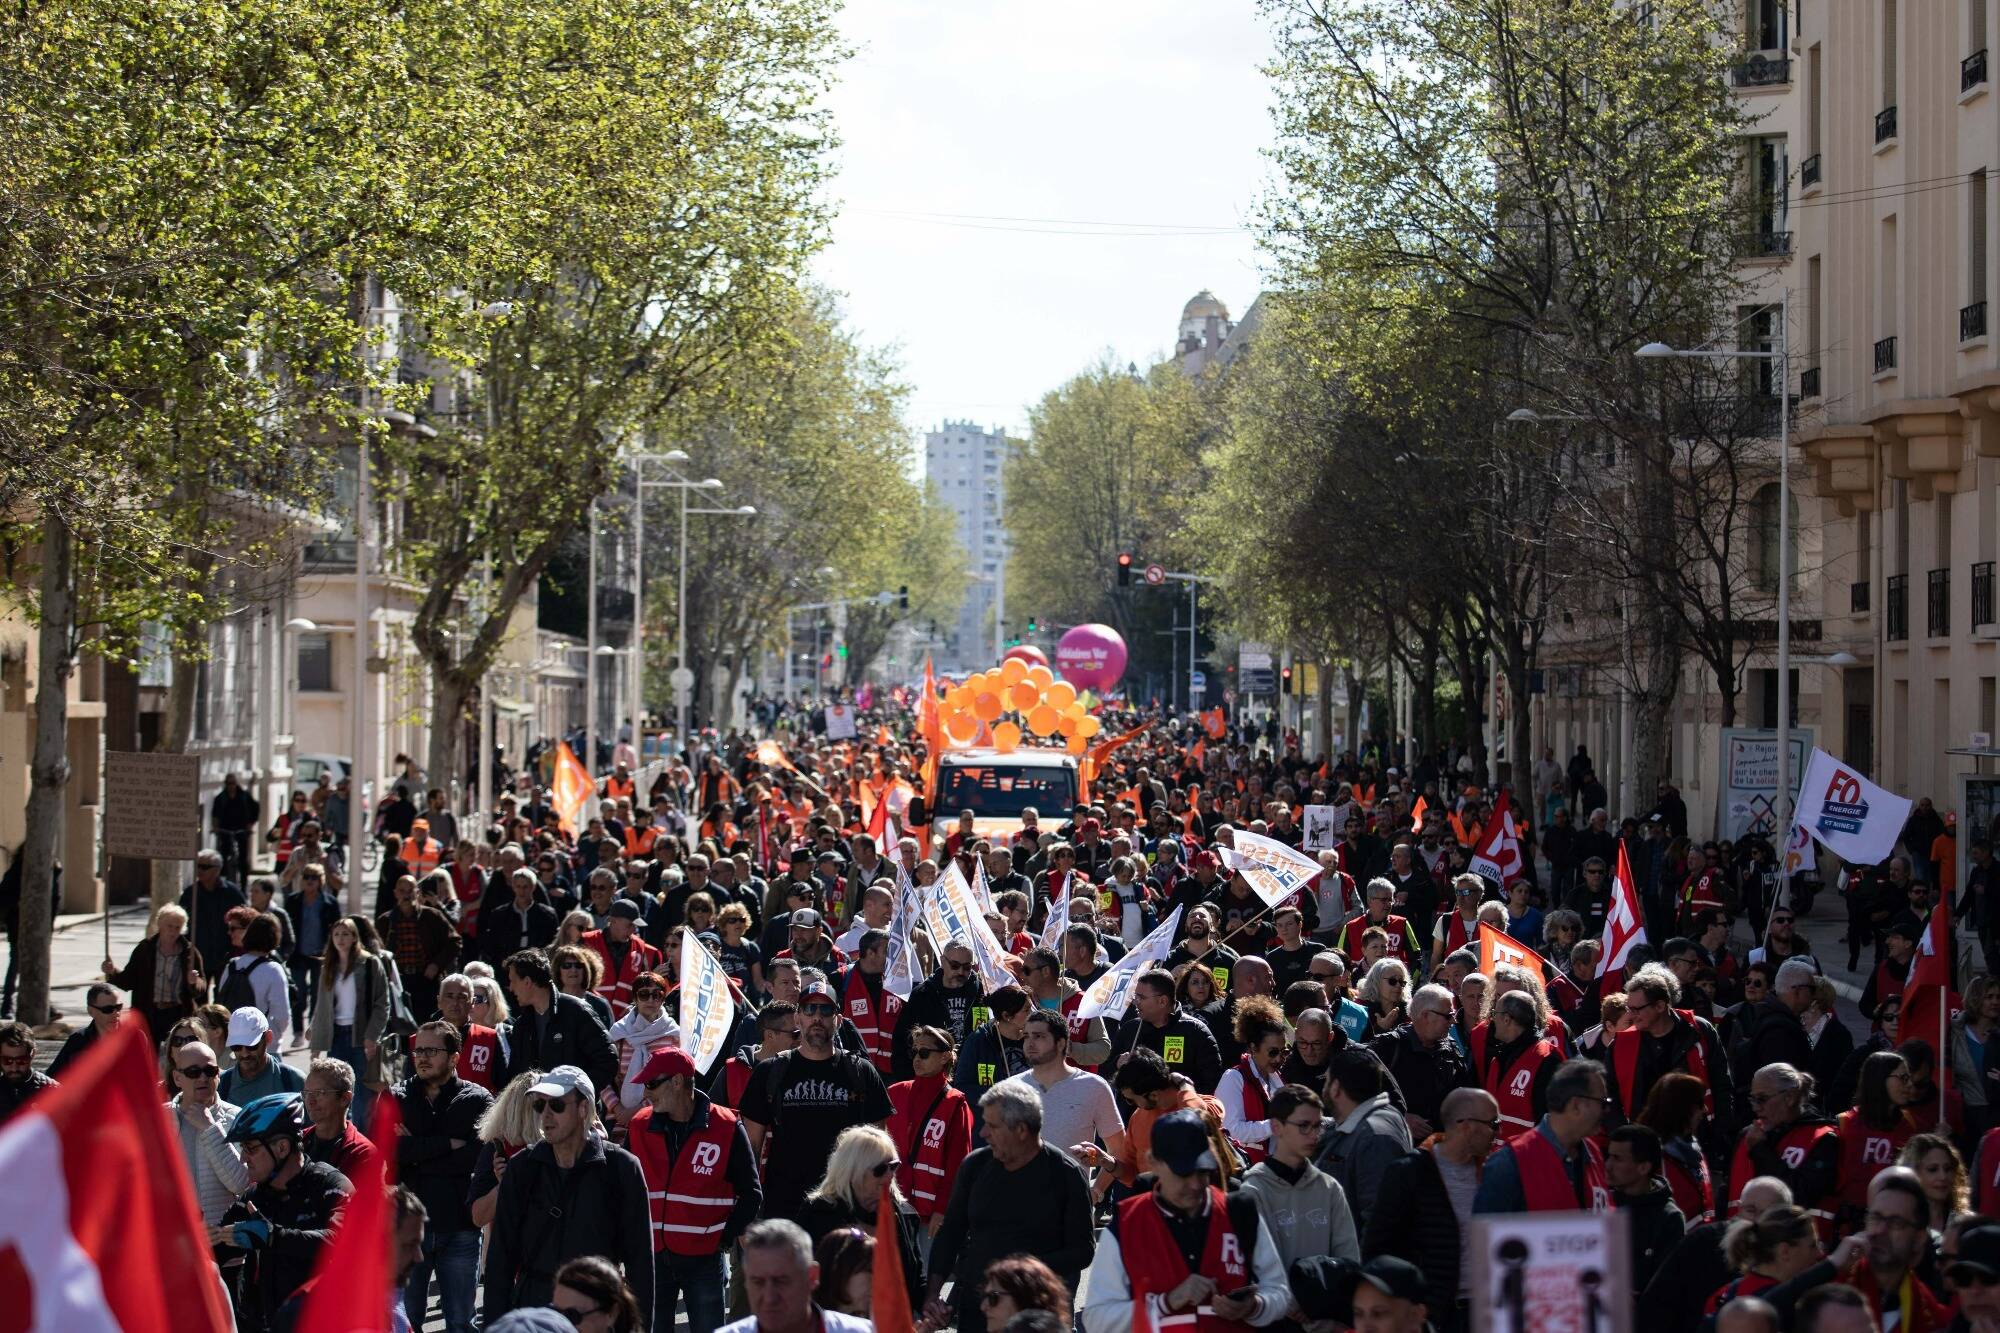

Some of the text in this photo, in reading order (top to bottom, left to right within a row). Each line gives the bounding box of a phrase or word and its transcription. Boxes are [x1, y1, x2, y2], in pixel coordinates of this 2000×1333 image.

[1824, 769, 1860, 805] FO
[470, 1044, 490, 1065] FO
[1167, 1047, 1182, 1062] FO
[472, 1064, 486, 1072] VAR
[1510, 1088, 1525, 1098] VAR
[923, 1118, 946, 1141] FO
[924, 1138, 940, 1149] VAR
[691, 1141, 721, 1167] FO
[1781, 1146, 1804, 1169] FO
[693, 1164, 713, 1176] VAR
[1545, 1234, 1600, 1251] STOP
